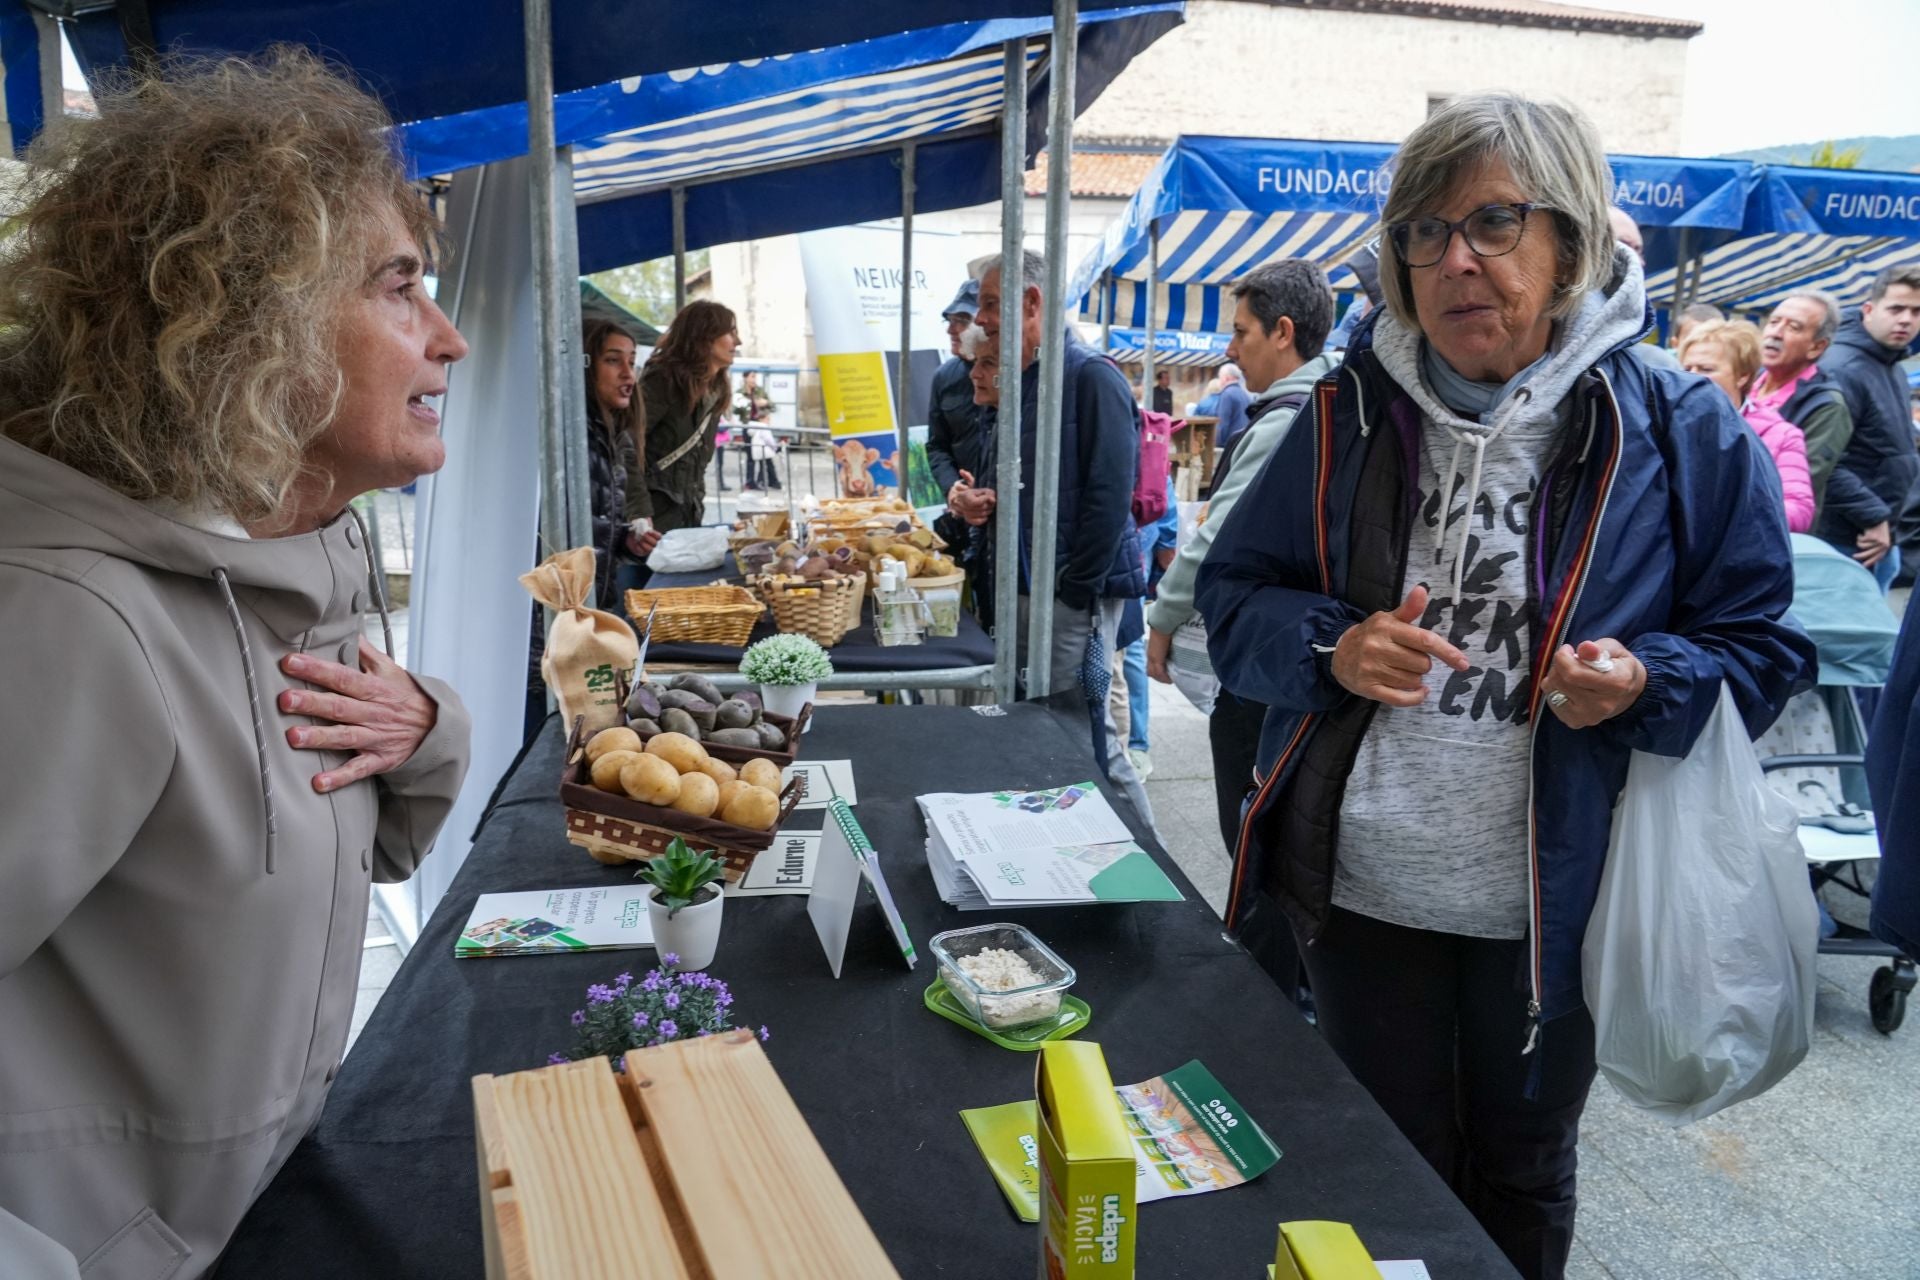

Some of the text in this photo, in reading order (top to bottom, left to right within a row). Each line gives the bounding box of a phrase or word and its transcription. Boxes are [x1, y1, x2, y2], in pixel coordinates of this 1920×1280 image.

[853, 267, 928, 289] NEIKR
[1176, 332, 1213, 350] Vital
[1418, 582, 1530, 671] EEK
[584, 664, 614, 687] 25
[776, 839, 806, 884] Edurne
[614, 899, 647, 928] udapa
[1018, 1134, 1040, 1170] dapa
[1093, 1194, 1127, 1264] udapa
